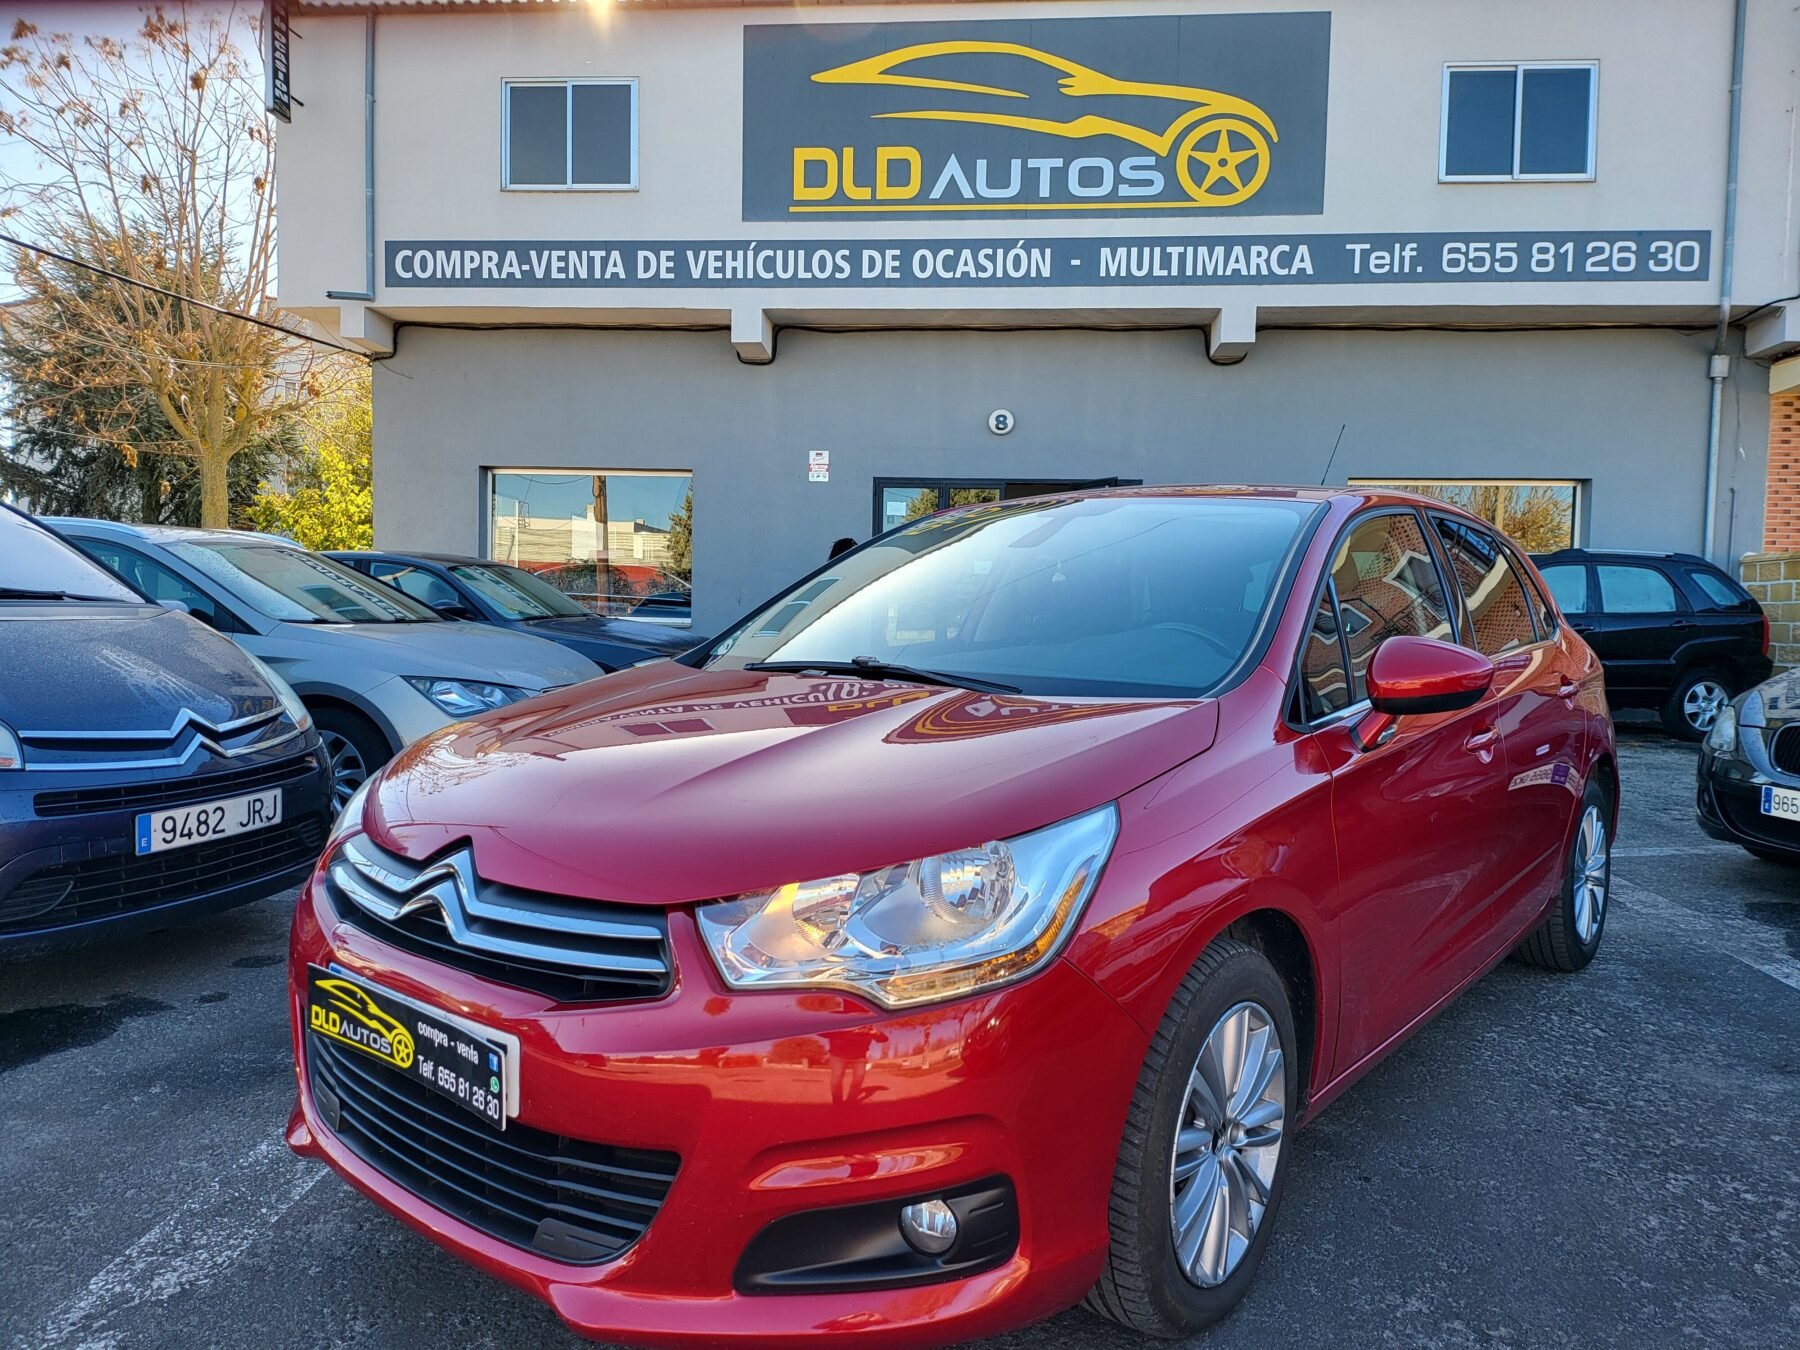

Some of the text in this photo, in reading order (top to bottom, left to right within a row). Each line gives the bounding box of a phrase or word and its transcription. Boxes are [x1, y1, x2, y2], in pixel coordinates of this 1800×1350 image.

[793, 146, 1165, 200] DLD AUTOS
[394, 249, 626, 279] COMPRA-VENTA
[637, 249, 675, 279] DE
[687, 242, 851, 279] VEHÍCULOS
[861, 249, 901, 279] DE
[912, 240, 1052, 279] OCASIÓN
[1100, 244, 1314, 277] MULTIMARCA
[1345, 242, 1423, 274] Telf.
[1441, 241, 1518, 273] 655
[1648, 240, 1700, 272] 30
[995, 414, 1008, 430] 8
[161, 794, 278, 844] 9482 JRJ
[1773, 794, 1800, 815] 965
[141, 837, 148, 847] E
[311, 1004, 392, 1054] DLD AUTOS
[417, 1021, 449, 1048] compra
[456, 1040, 479, 1065] venta
[417, 1054, 500, 1120] Telf. 655 81 26 30
